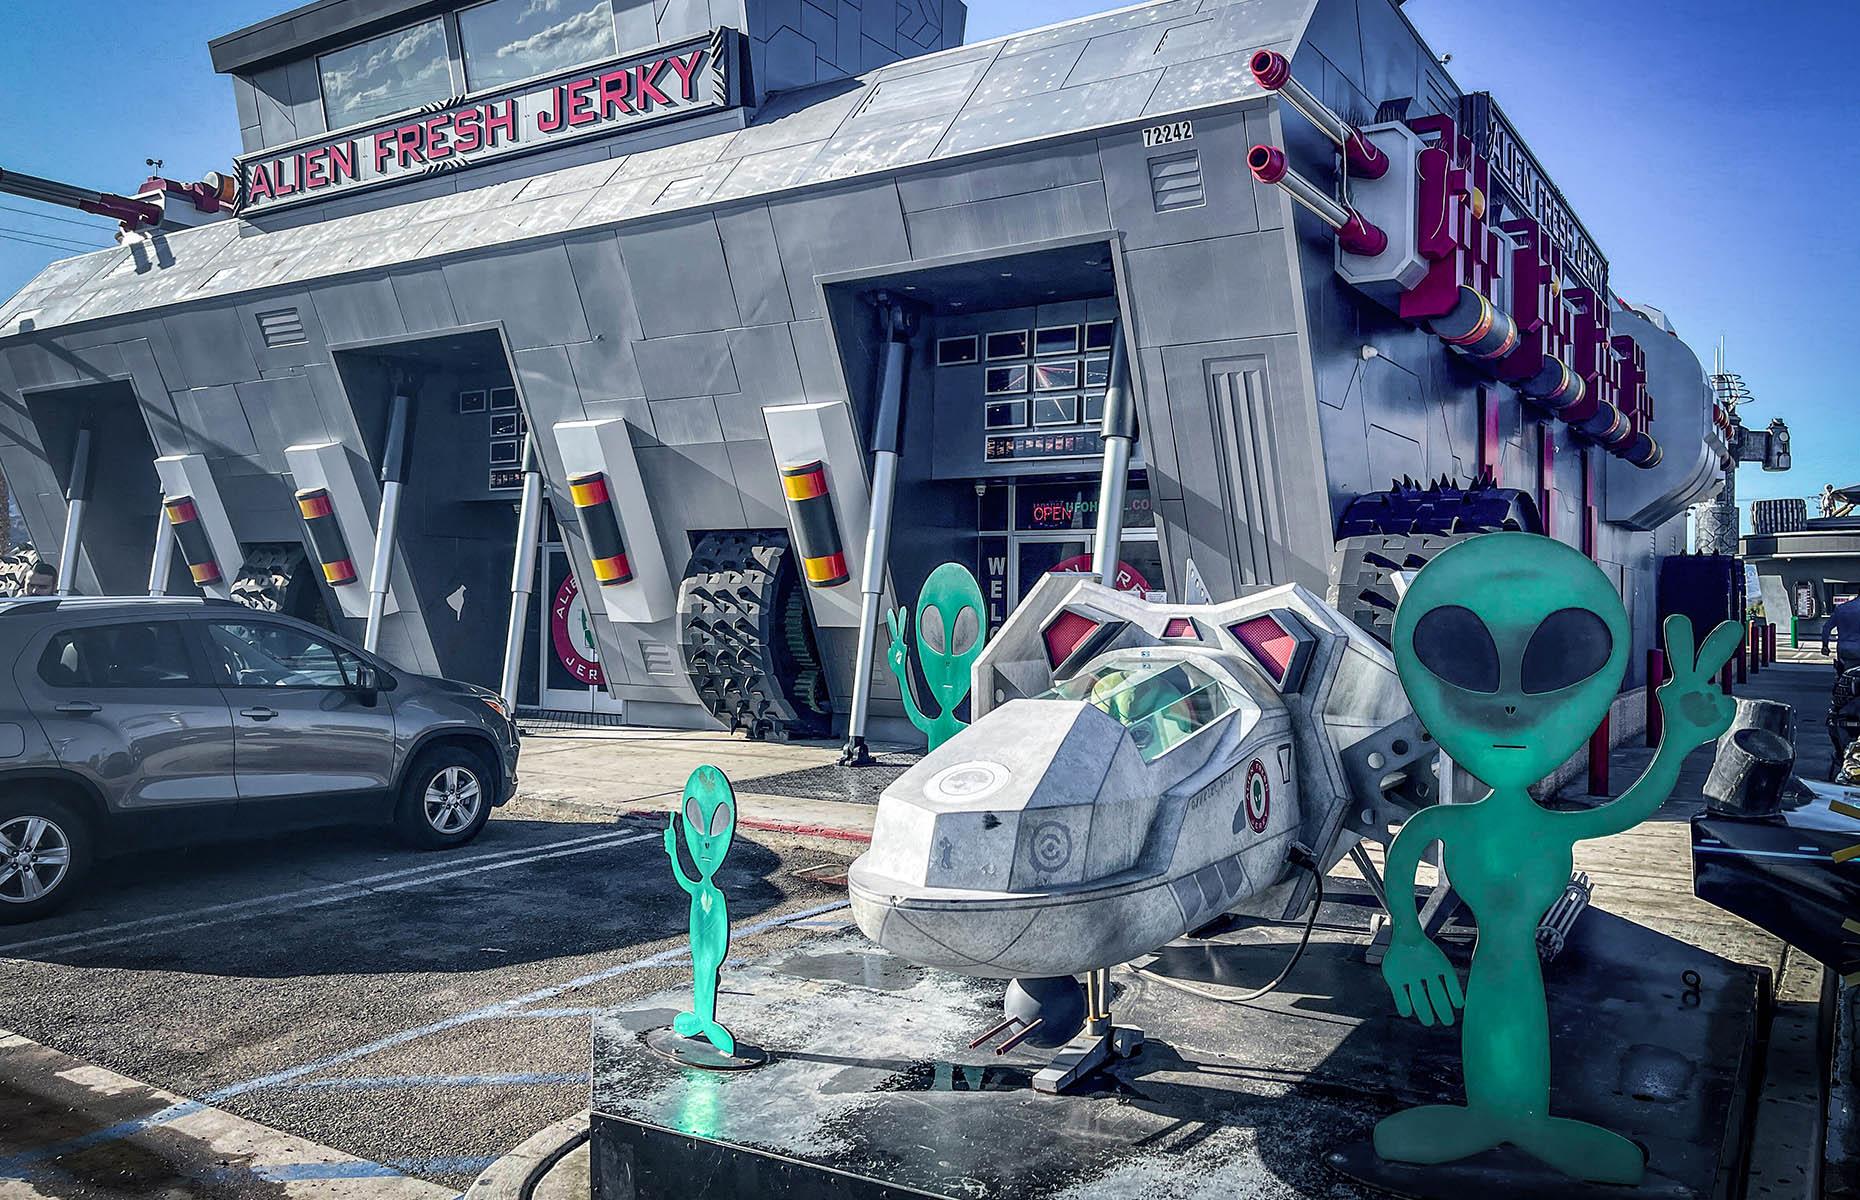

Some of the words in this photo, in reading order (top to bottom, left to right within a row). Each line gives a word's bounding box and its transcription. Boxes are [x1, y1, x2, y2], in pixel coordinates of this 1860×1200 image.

[248, 140, 356, 202] ALIEN
[374, 98, 517, 173] FRESH
[538, 50, 704, 133] JERKY
[1143, 121, 1192, 146] 72242
[1491, 122, 1533, 207] ALIEN
[1536, 179, 1575, 258] FRESH
[1576, 237, 1608, 294] JERKY
[1033, 506, 1072, 521] OPEN
[565, 657, 598, 680] JER
